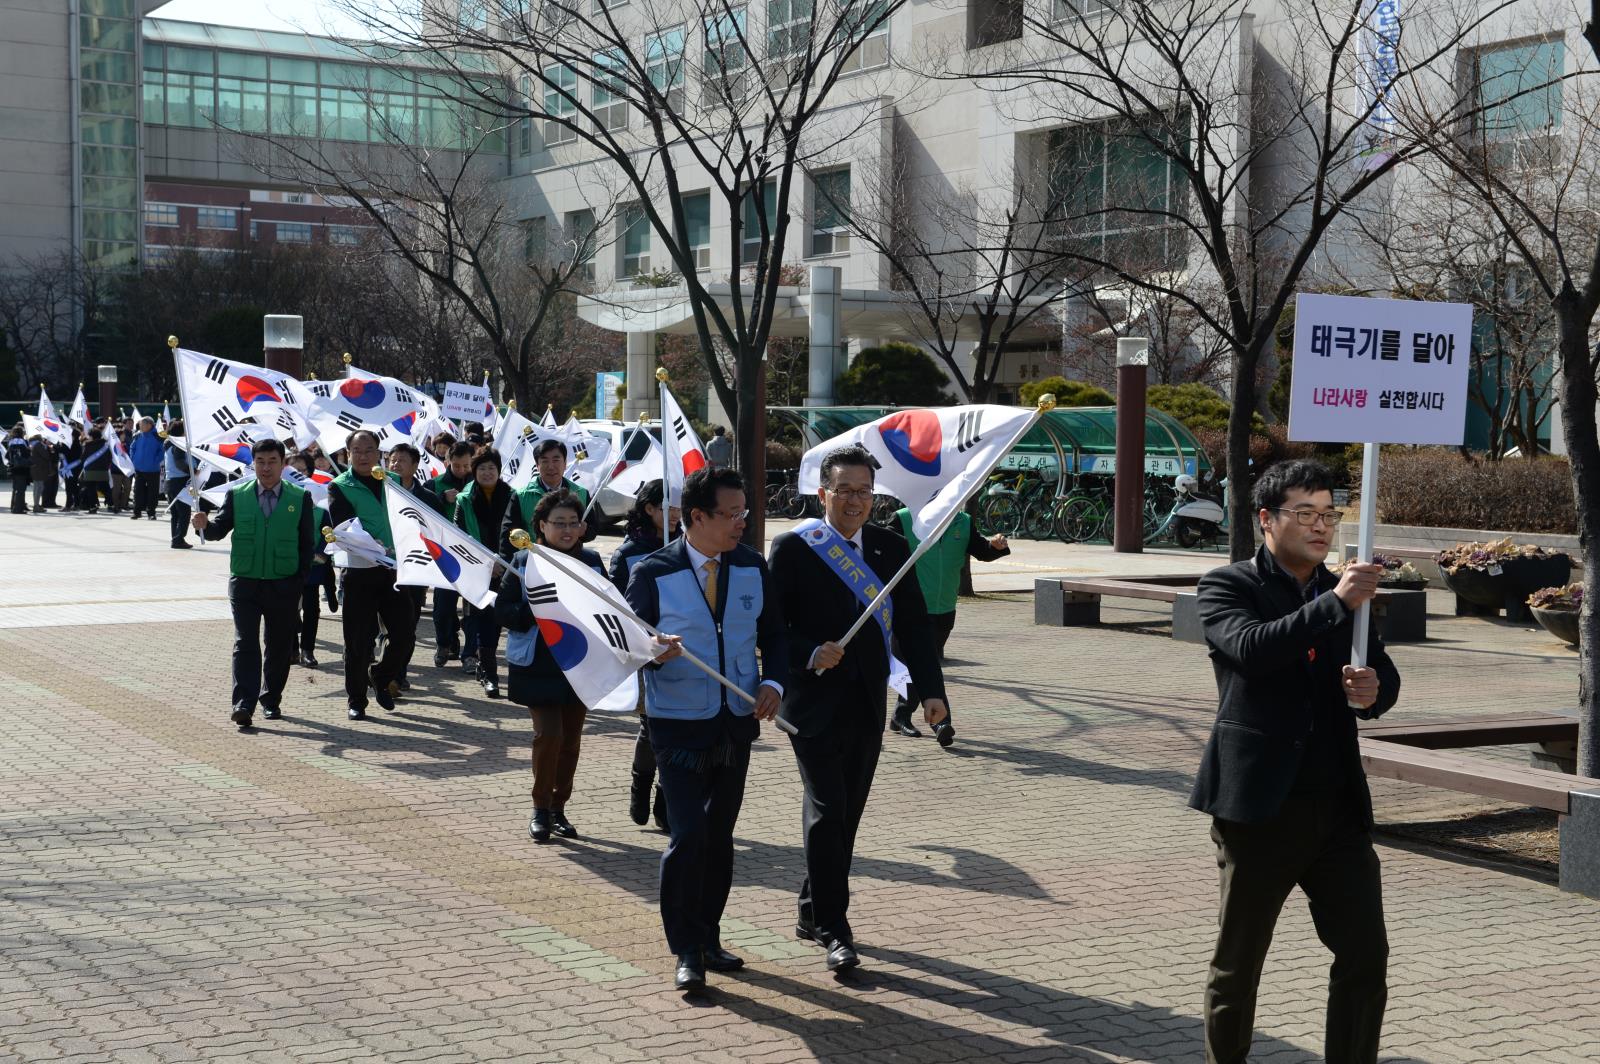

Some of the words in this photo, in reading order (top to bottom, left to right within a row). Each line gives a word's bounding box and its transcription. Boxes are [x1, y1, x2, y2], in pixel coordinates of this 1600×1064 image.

[1311, 325, 1400, 361] 태극기를
[1413, 332, 1455, 364] 달아
[1313, 387, 1368, 408] 나라사랑
[1379, 390, 1445, 411] 실천합시다
[828, 545, 866, 583] 태극기
